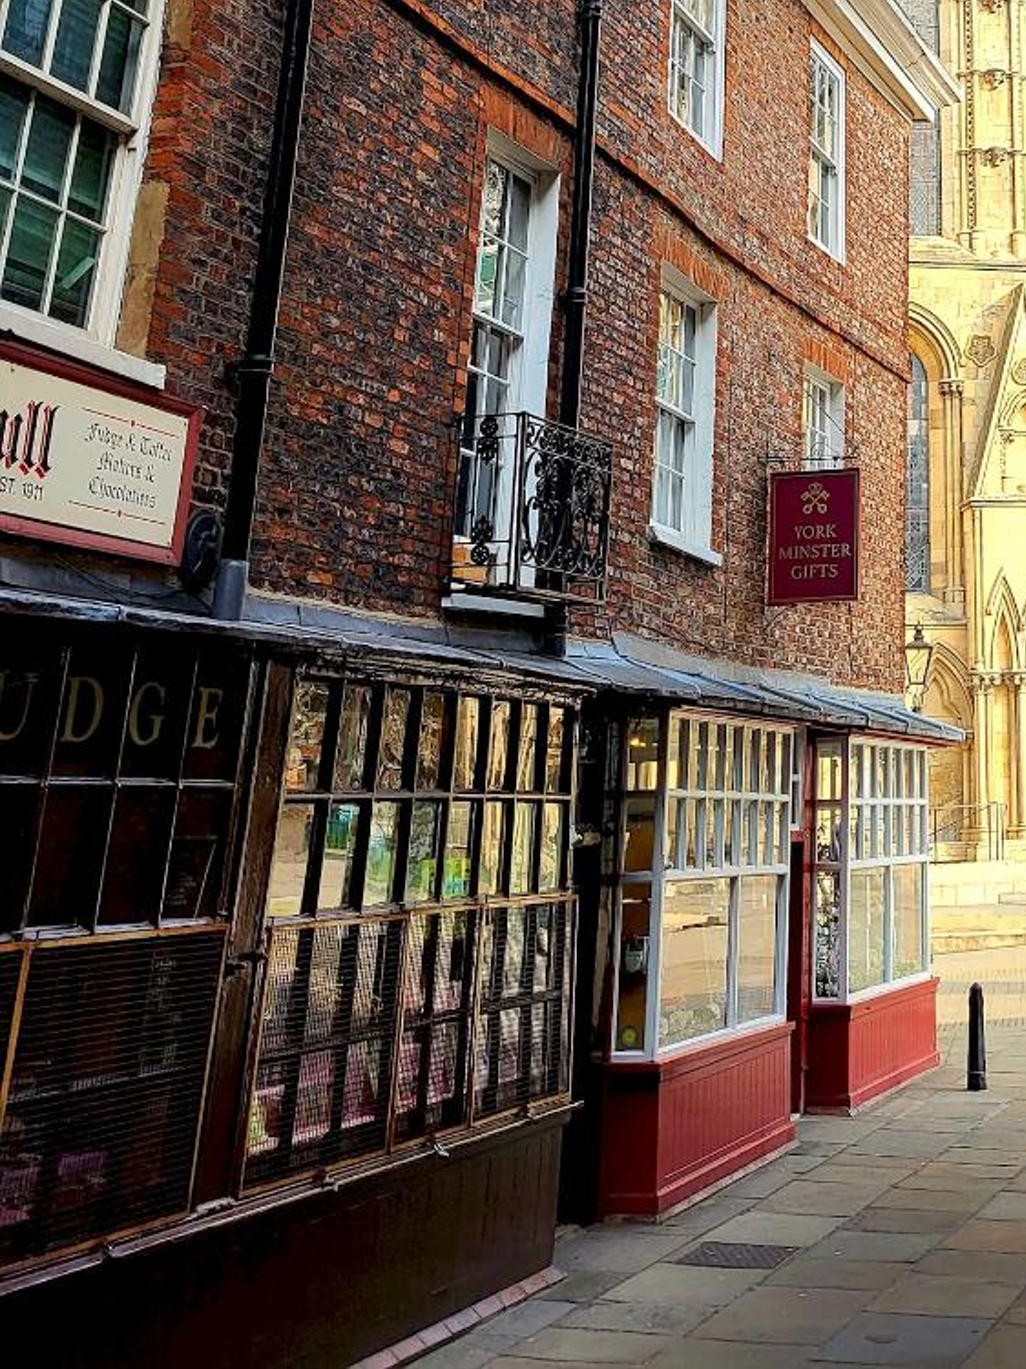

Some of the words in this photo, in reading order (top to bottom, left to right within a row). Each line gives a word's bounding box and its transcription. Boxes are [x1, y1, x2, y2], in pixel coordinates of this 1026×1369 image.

[84, 422, 123, 450] Fudge
[125, 432, 137, 452] &
[143, 463, 155, 483] &
[793, 522, 838, 540] YORK
[778, 543, 852, 560] MINSTER
[790, 563, 839, 580] GIFTS
